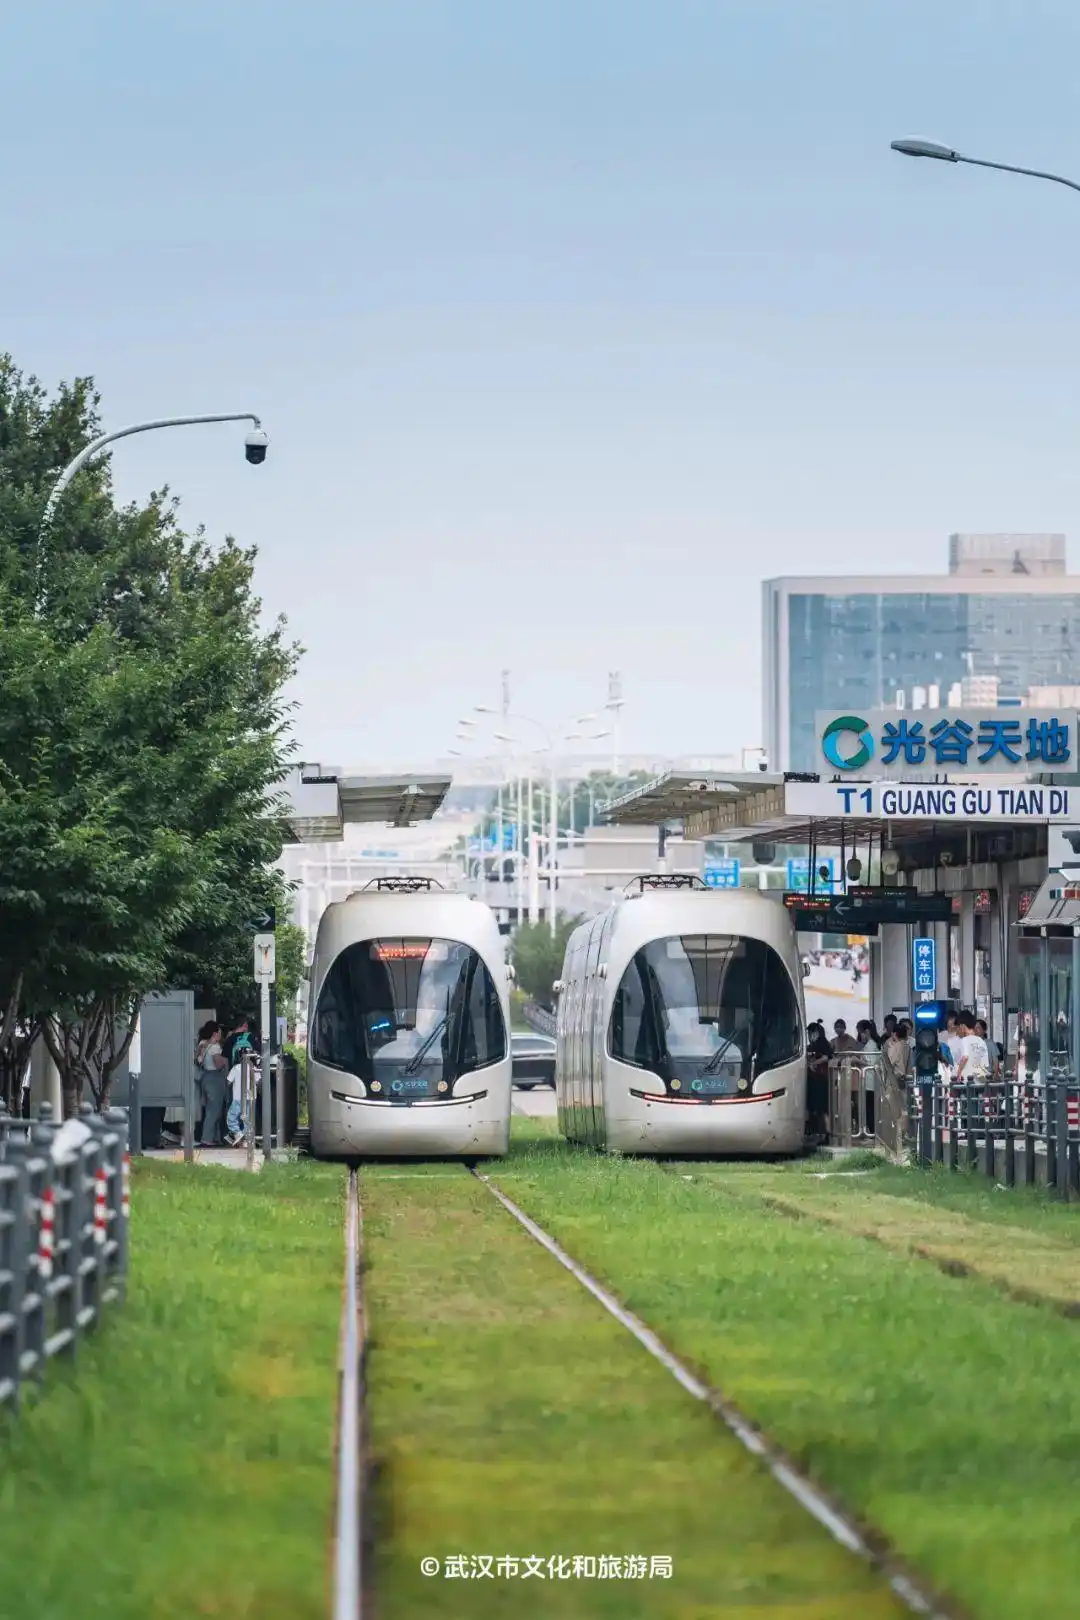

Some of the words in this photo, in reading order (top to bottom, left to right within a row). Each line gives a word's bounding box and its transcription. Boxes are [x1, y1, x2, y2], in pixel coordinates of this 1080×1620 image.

[880, 718, 1071, 765] 光谷天地
[837, 788, 873, 814] T1
[882, 789, 956, 815] GUANG
[962, 789, 991, 815] GU
[997, 789, 1044, 815] TIAN
[1050, 789, 1068, 815] DI
[918, 944, 932, 985] 停车位
